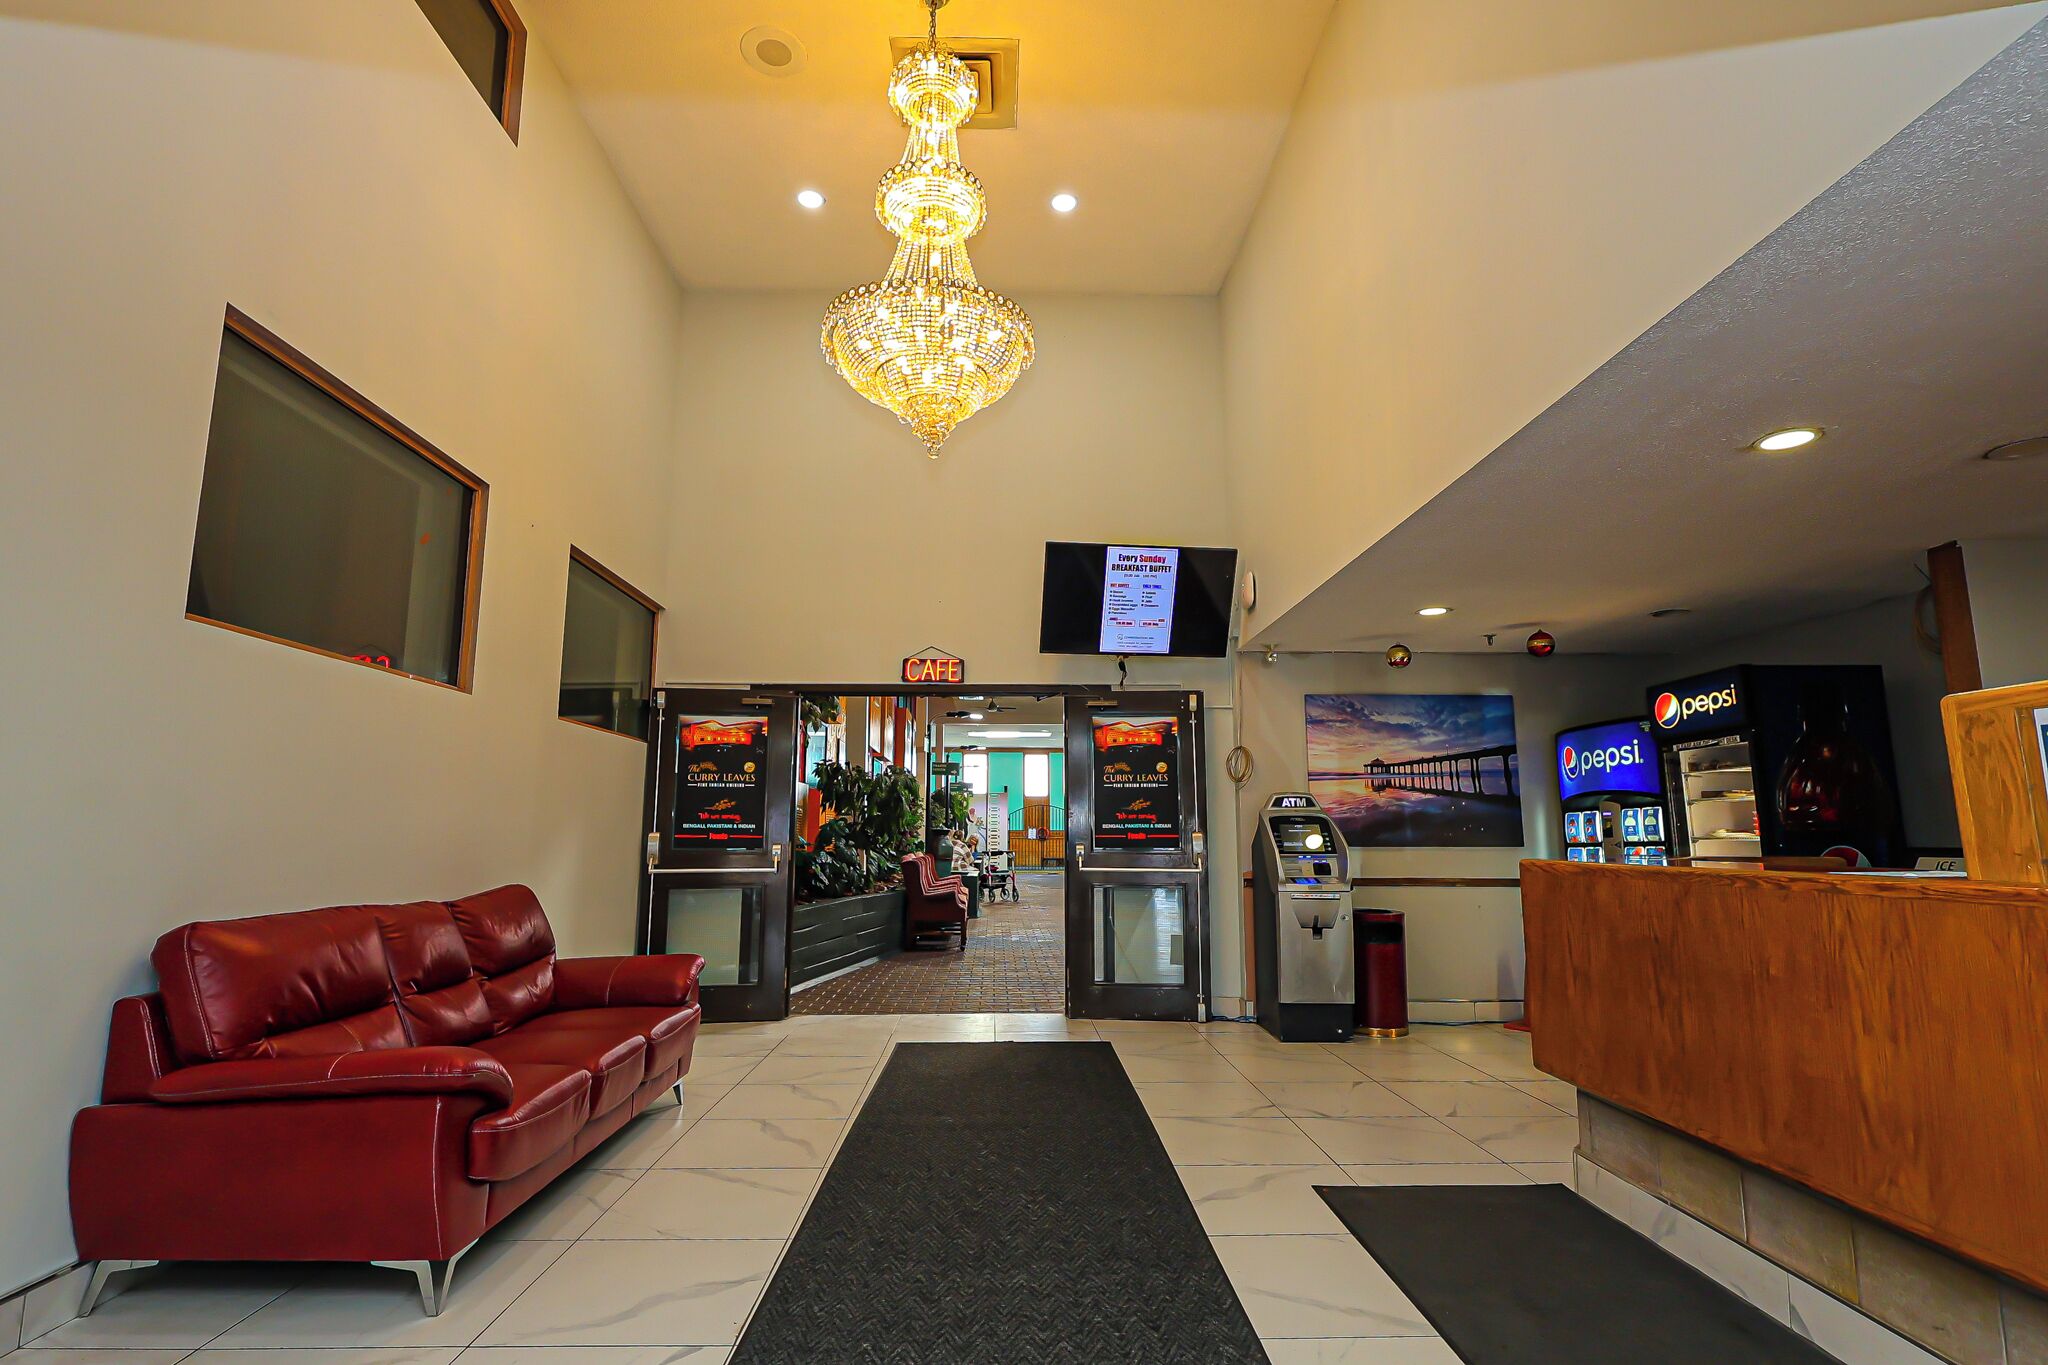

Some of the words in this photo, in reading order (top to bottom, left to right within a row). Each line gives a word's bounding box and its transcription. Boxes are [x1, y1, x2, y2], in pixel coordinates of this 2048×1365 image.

[1119, 554, 1138, 563] Every
[1139, 555, 1166, 564] Sunday
[907, 659, 959, 682] CAFE
[1682, 684, 1736, 719] pepsi
[1582, 739, 1639, 775] pepsi
[1104, 774, 1133, 782] CURRY
[1282, 798, 1306, 807] ATM
[1935, 861, 1956, 871] ICE
